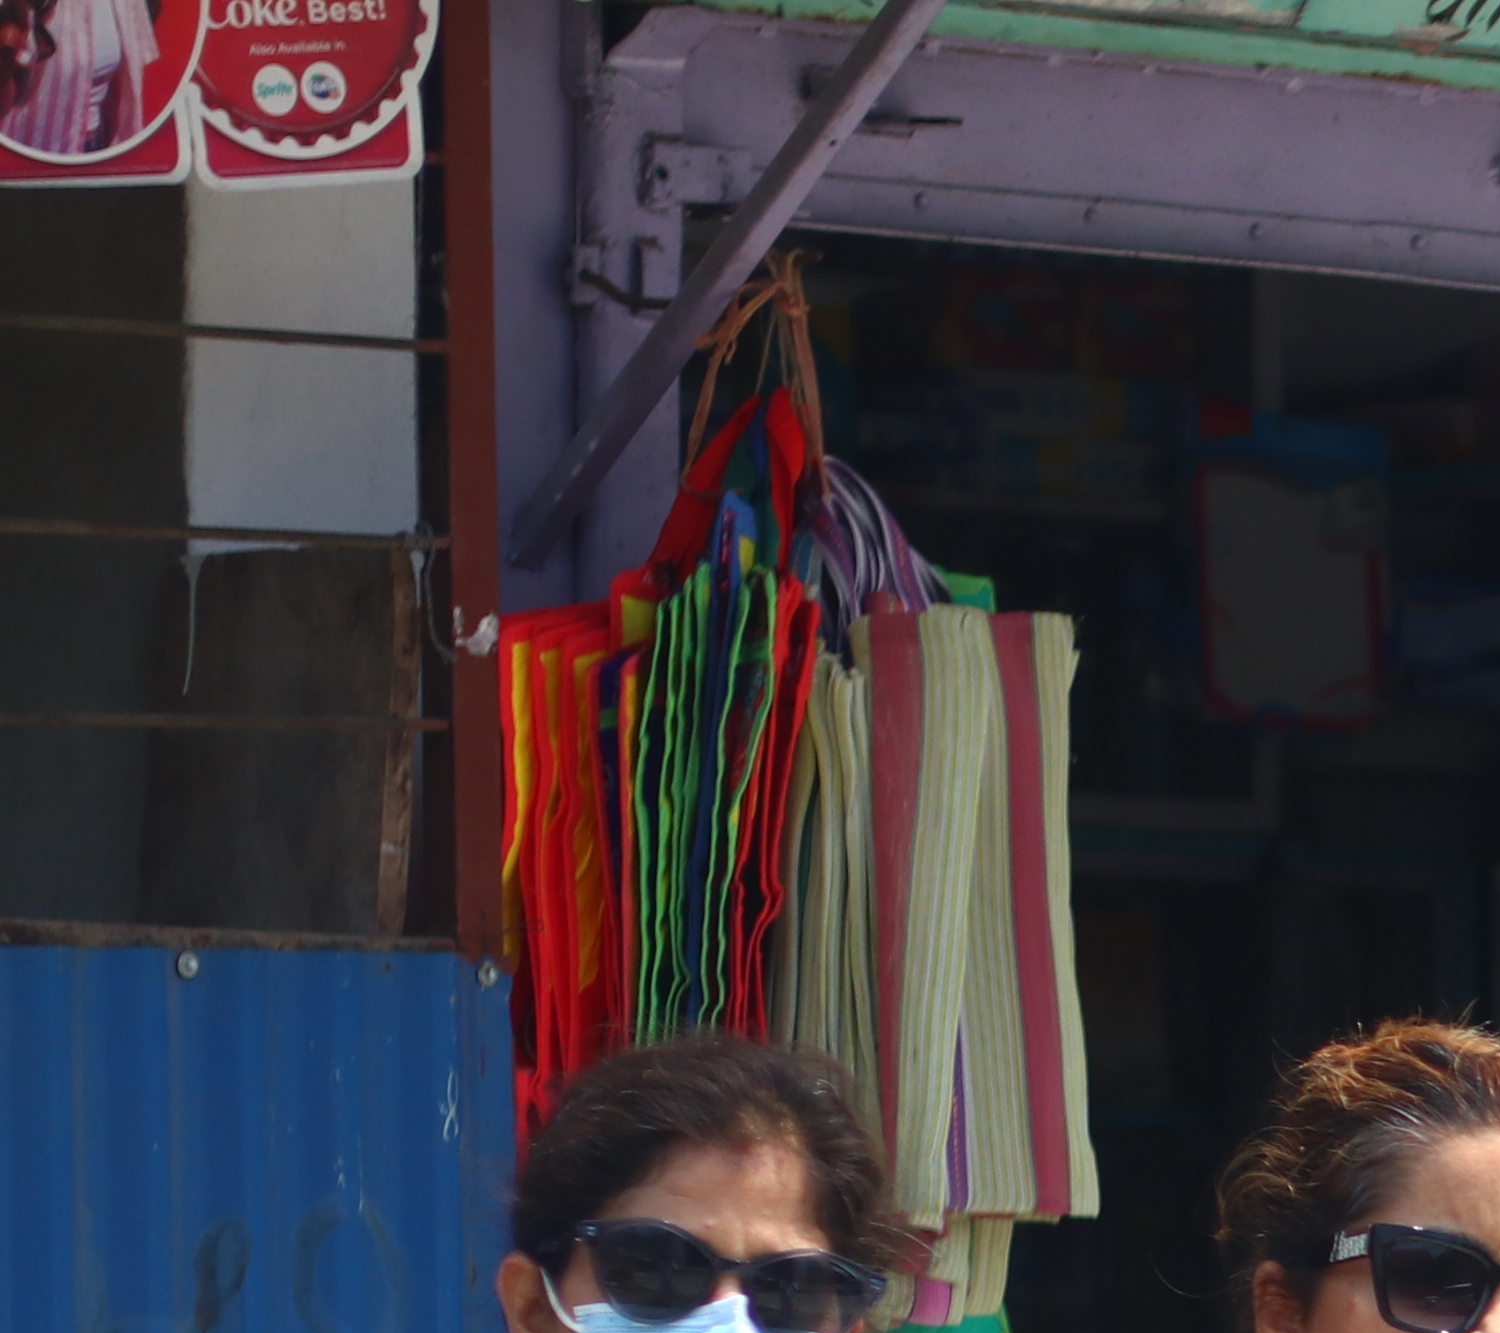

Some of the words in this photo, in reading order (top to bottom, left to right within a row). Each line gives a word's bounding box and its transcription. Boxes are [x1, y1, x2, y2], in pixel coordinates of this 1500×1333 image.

[307, 0, 388, 24] Best!
[278, 41, 331, 56] Available
[256, 79, 296, 100] Sprite
